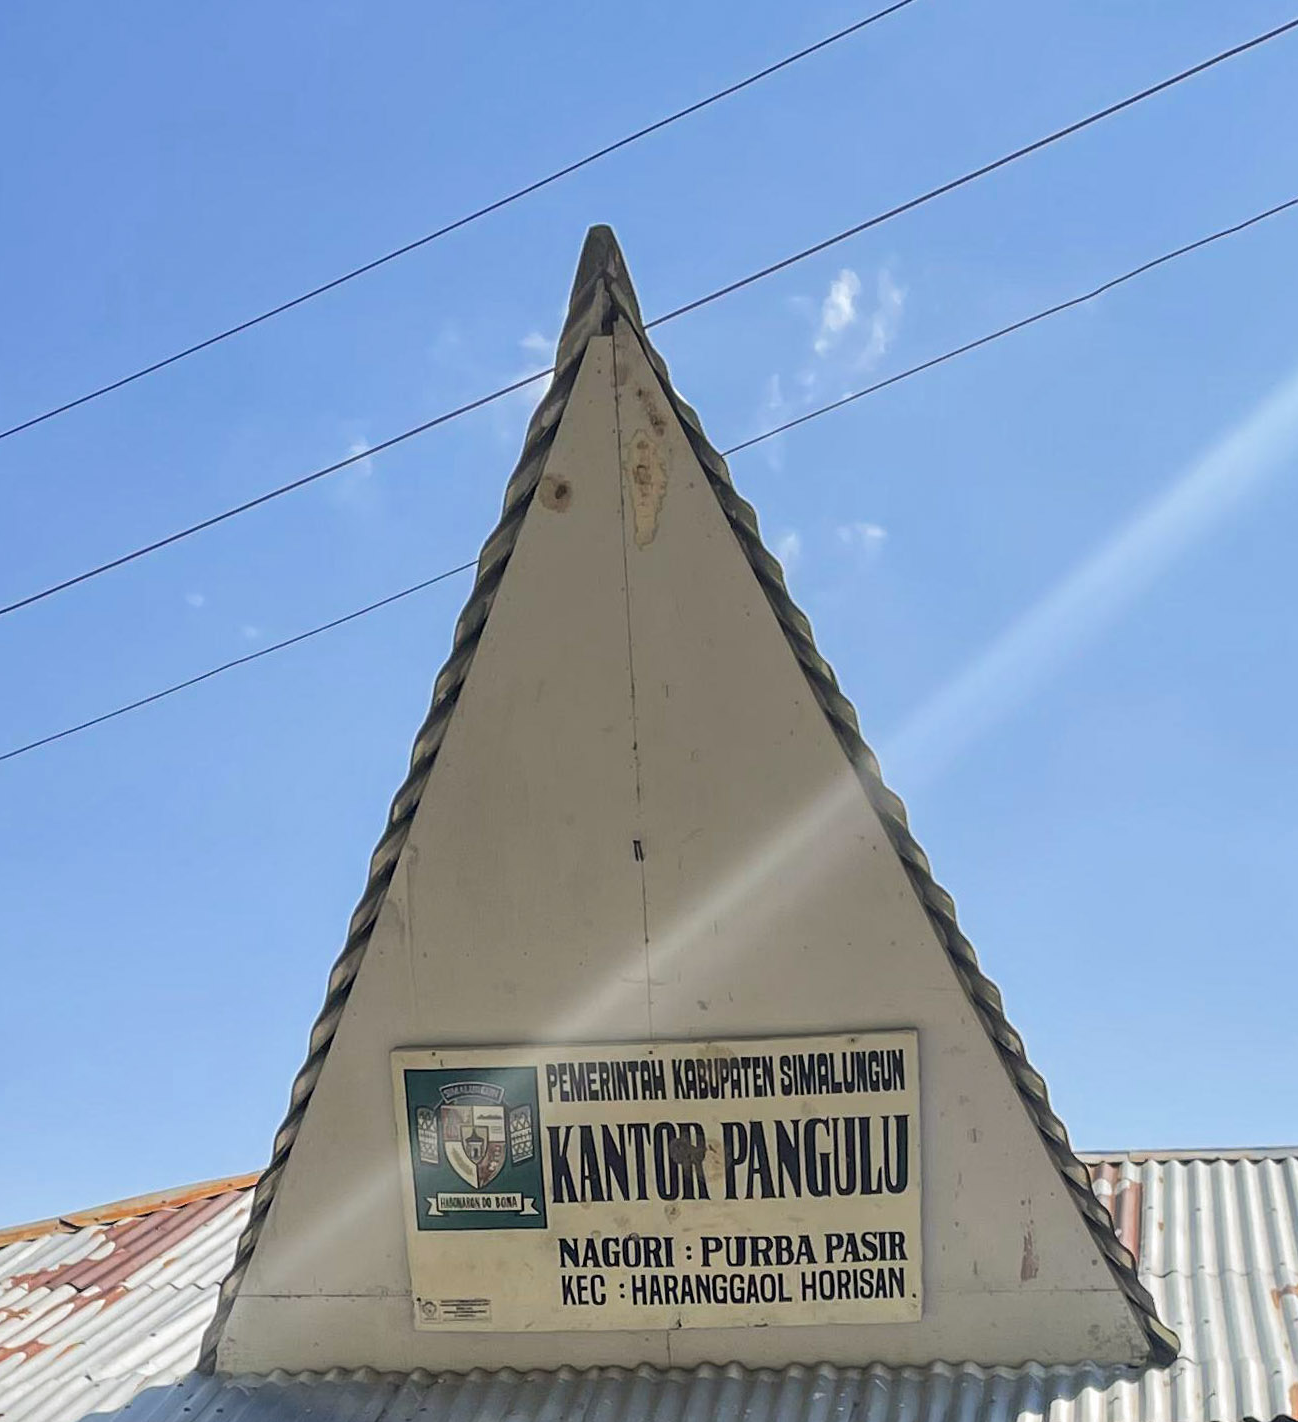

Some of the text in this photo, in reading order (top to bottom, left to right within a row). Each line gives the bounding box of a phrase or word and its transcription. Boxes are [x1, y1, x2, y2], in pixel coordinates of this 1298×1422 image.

[546, 1049, 905, 1103] PEMERINTAH KABUPATEN SIMALUNGUN
[546, 1114, 910, 1205] KANTOR PANGULU
[559, 1236, 675, 1269] NAGORI
[700, 1234, 817, 1267] PURBA
[824, 1232, 908, 1263] PASIR
[561, 1274, 606, 1306] KEC
[801, 1267, 905, 1302] HORISAN
